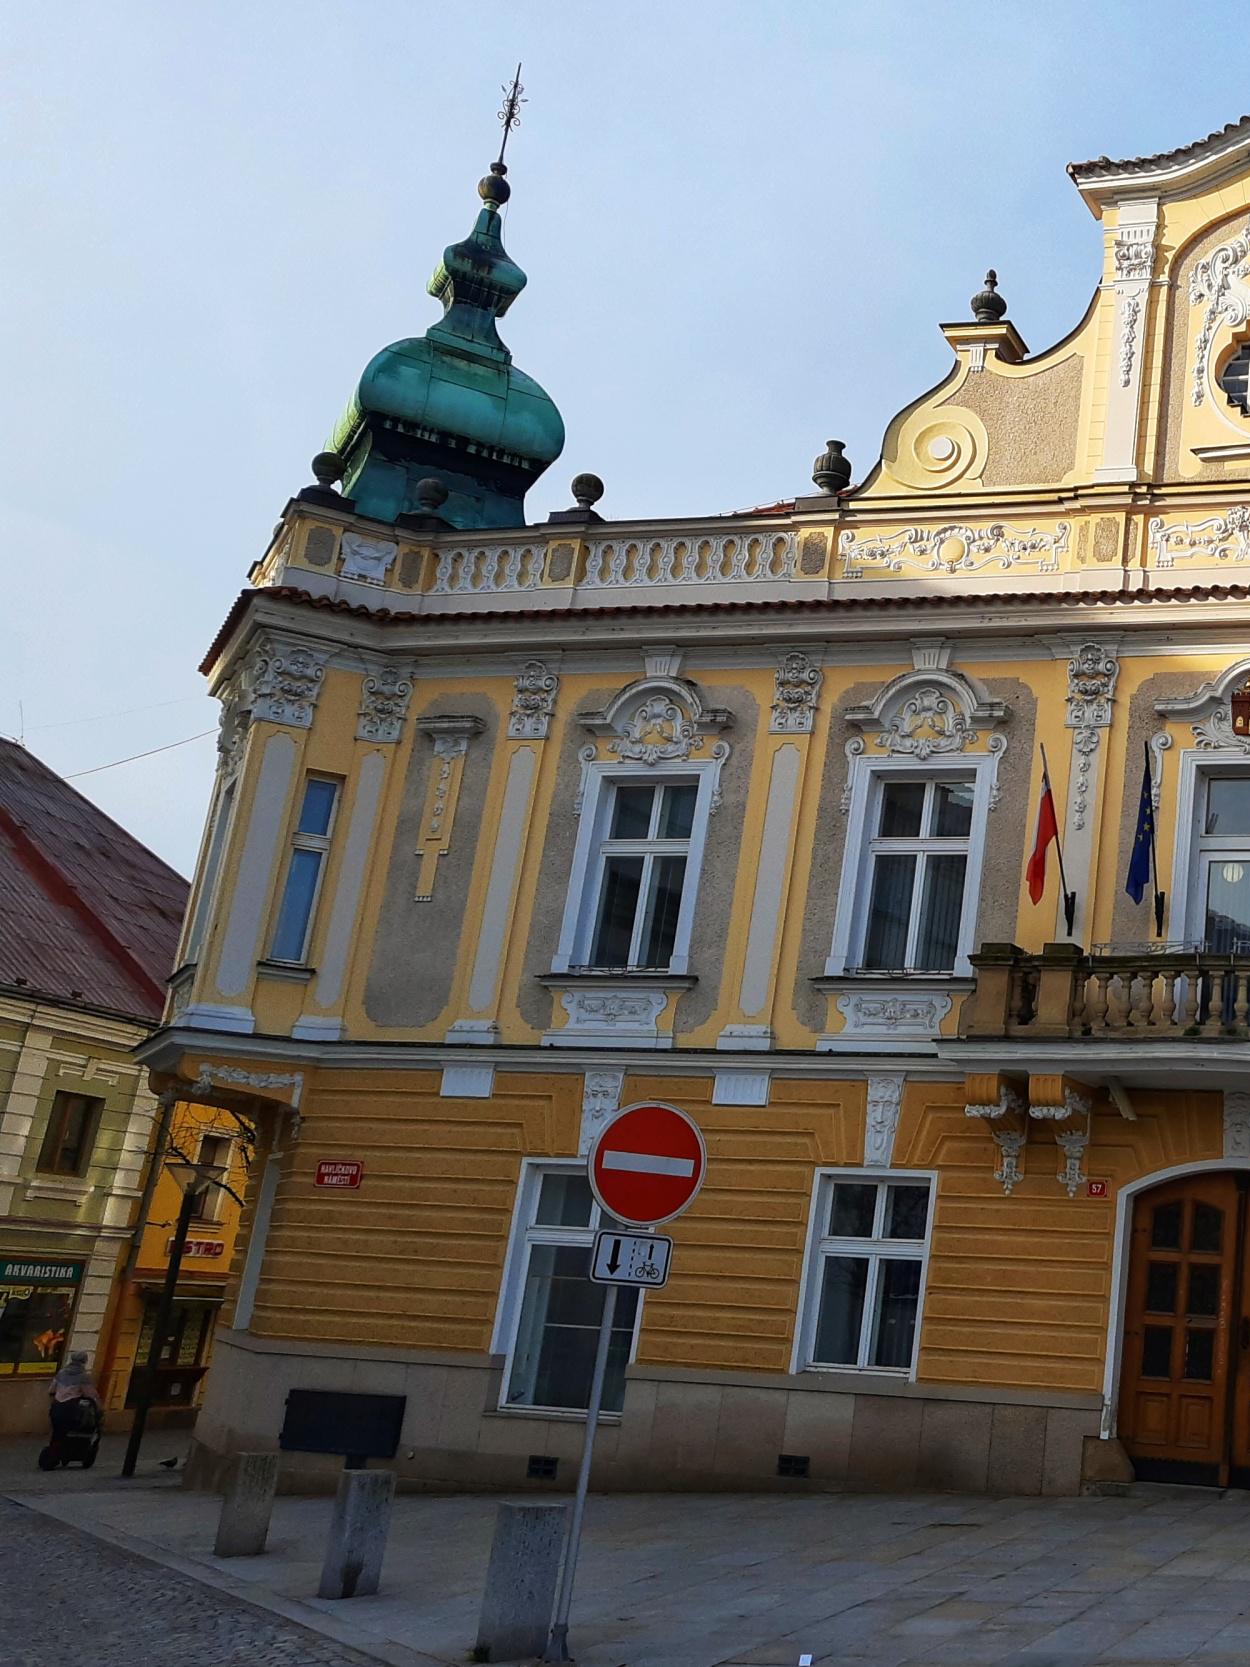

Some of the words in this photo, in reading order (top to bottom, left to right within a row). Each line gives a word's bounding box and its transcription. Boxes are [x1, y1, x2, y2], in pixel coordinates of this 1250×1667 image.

[1091, 1184, 1102, 1193] 57
[168, 1240, 225, 1256] STRO
[5, 1264, 73, 1278] AKVARISTIKA
